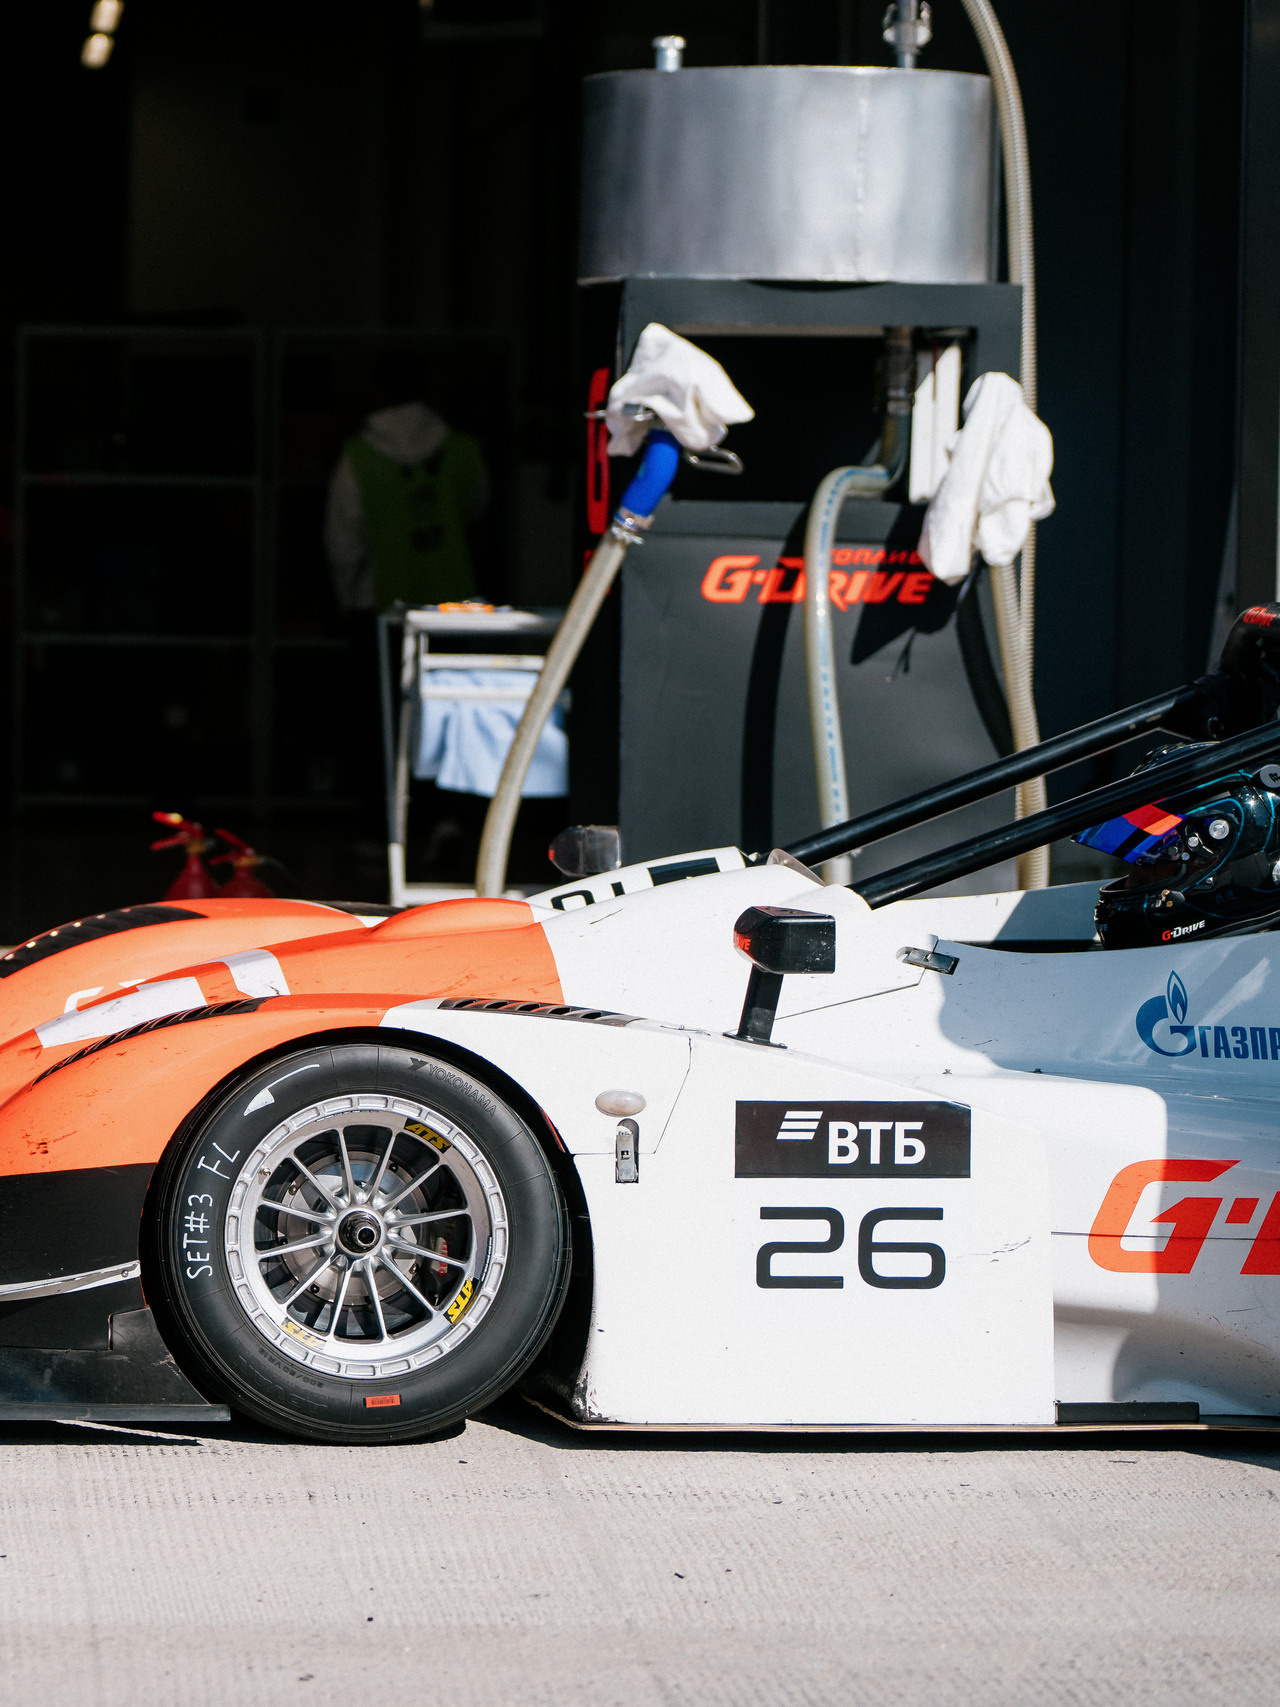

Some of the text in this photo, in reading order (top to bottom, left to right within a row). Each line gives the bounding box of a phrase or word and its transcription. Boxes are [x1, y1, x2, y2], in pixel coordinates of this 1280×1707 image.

[428, 1063, 498, 1118] YOKOHAMA
[404, 1123, 452, 1150] ATS
[827, 1121, 926, 1165] ВТБ
[197, 1142, 240, 1179] FL
[756, 1206, 946, 1289] 26
[447, 1279, 475, 1323] ATS
